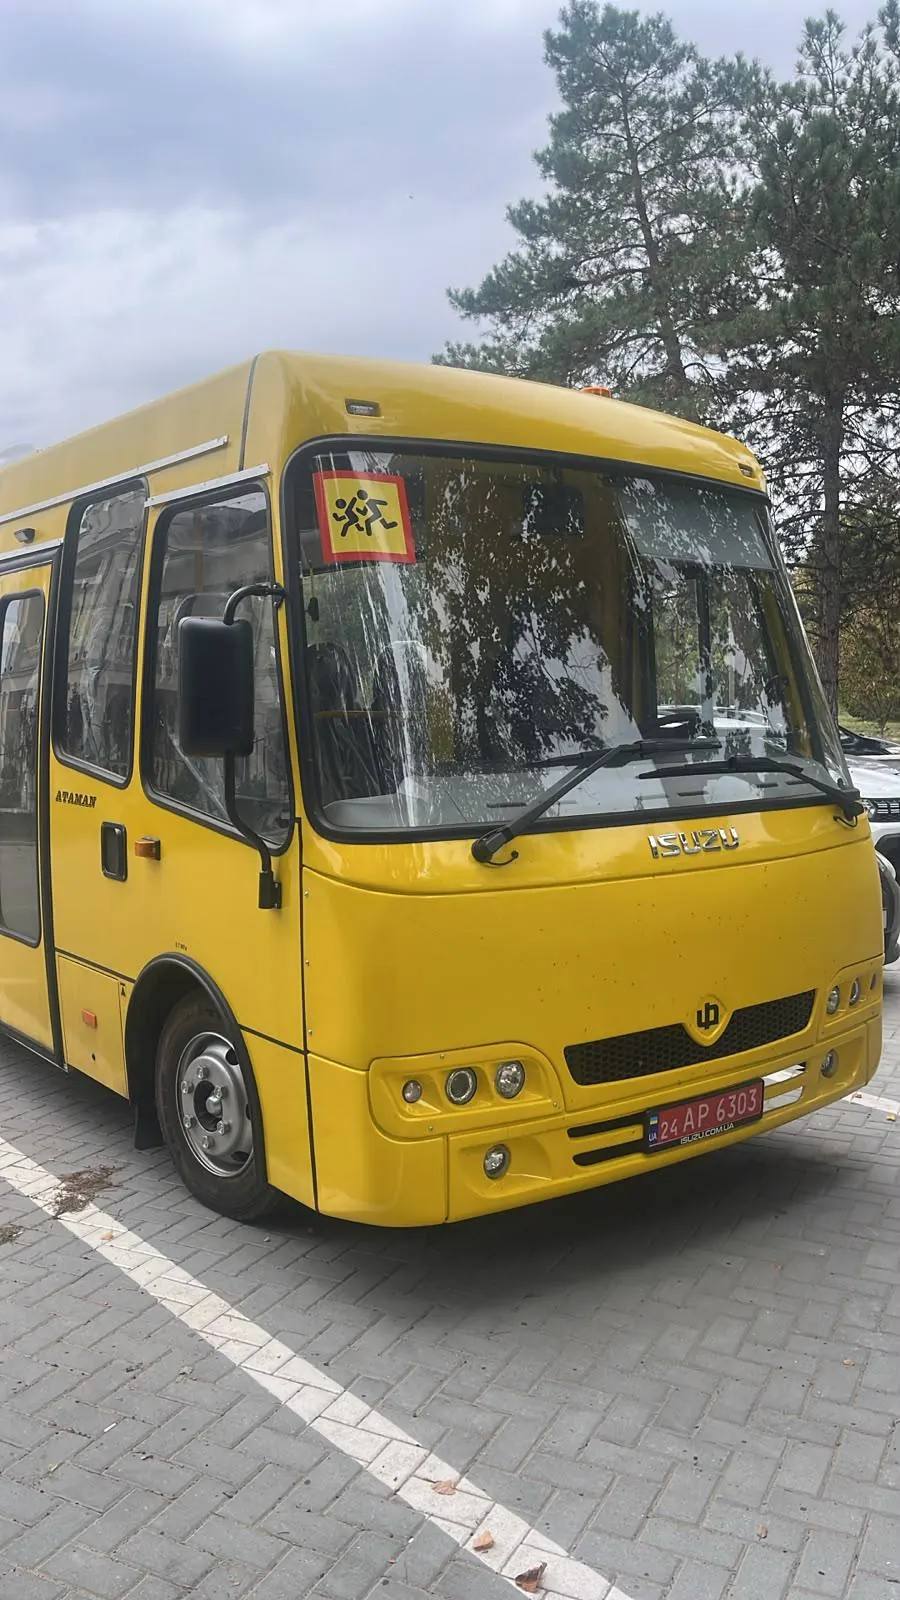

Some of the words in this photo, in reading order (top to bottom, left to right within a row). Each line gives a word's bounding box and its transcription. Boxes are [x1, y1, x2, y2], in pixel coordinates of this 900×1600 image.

[55, 790, 97, 808] ATAMAN
[648, 826, 739, 858] ISUZU
[660, 1118, 678, 1140] 24
[683, 1103, 709, 1132] AP
[716, 1088, 757, 1122] 6303
[648, 1131, 657, 1142] UA
